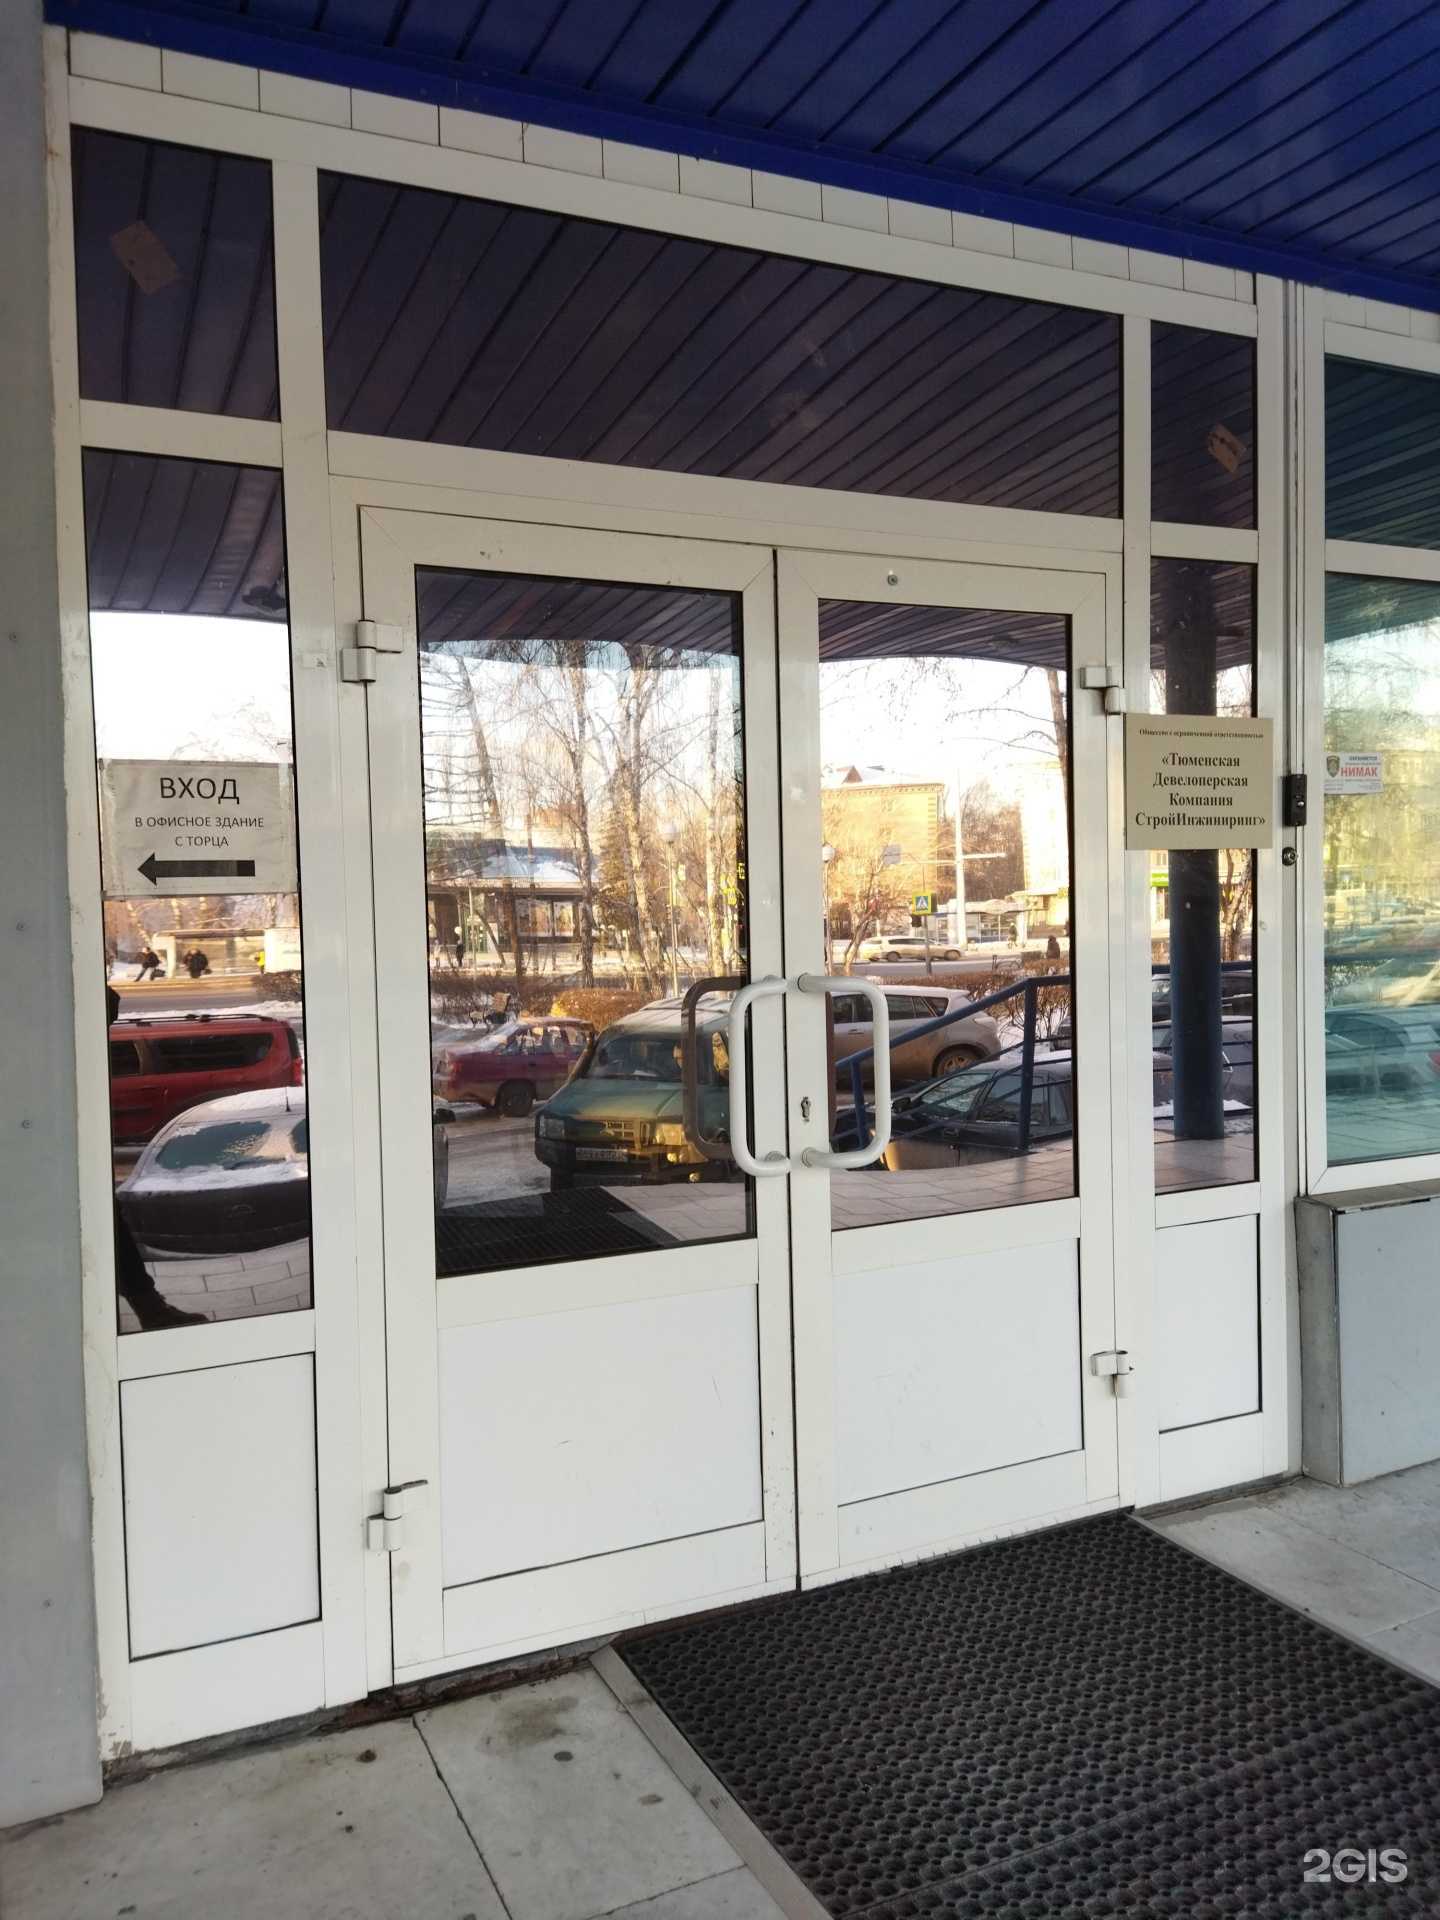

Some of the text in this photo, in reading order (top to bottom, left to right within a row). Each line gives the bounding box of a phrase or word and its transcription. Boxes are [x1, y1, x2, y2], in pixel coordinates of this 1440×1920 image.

[1162, 752, 1240, 767] «Тюменская
[1153, 772, 1248, 790] Девелоперская
[160, 777, 240, 805] ВХОД
[1169, 792, 1233, 806] Компания
[135, 816, 265, 830] В ОФИСНОЕ ЗДАНИЕ
[1135, 811, 1266, 829] СтройИнжиниринг»
[175, 836, 229, 848] С ТОРЦА
